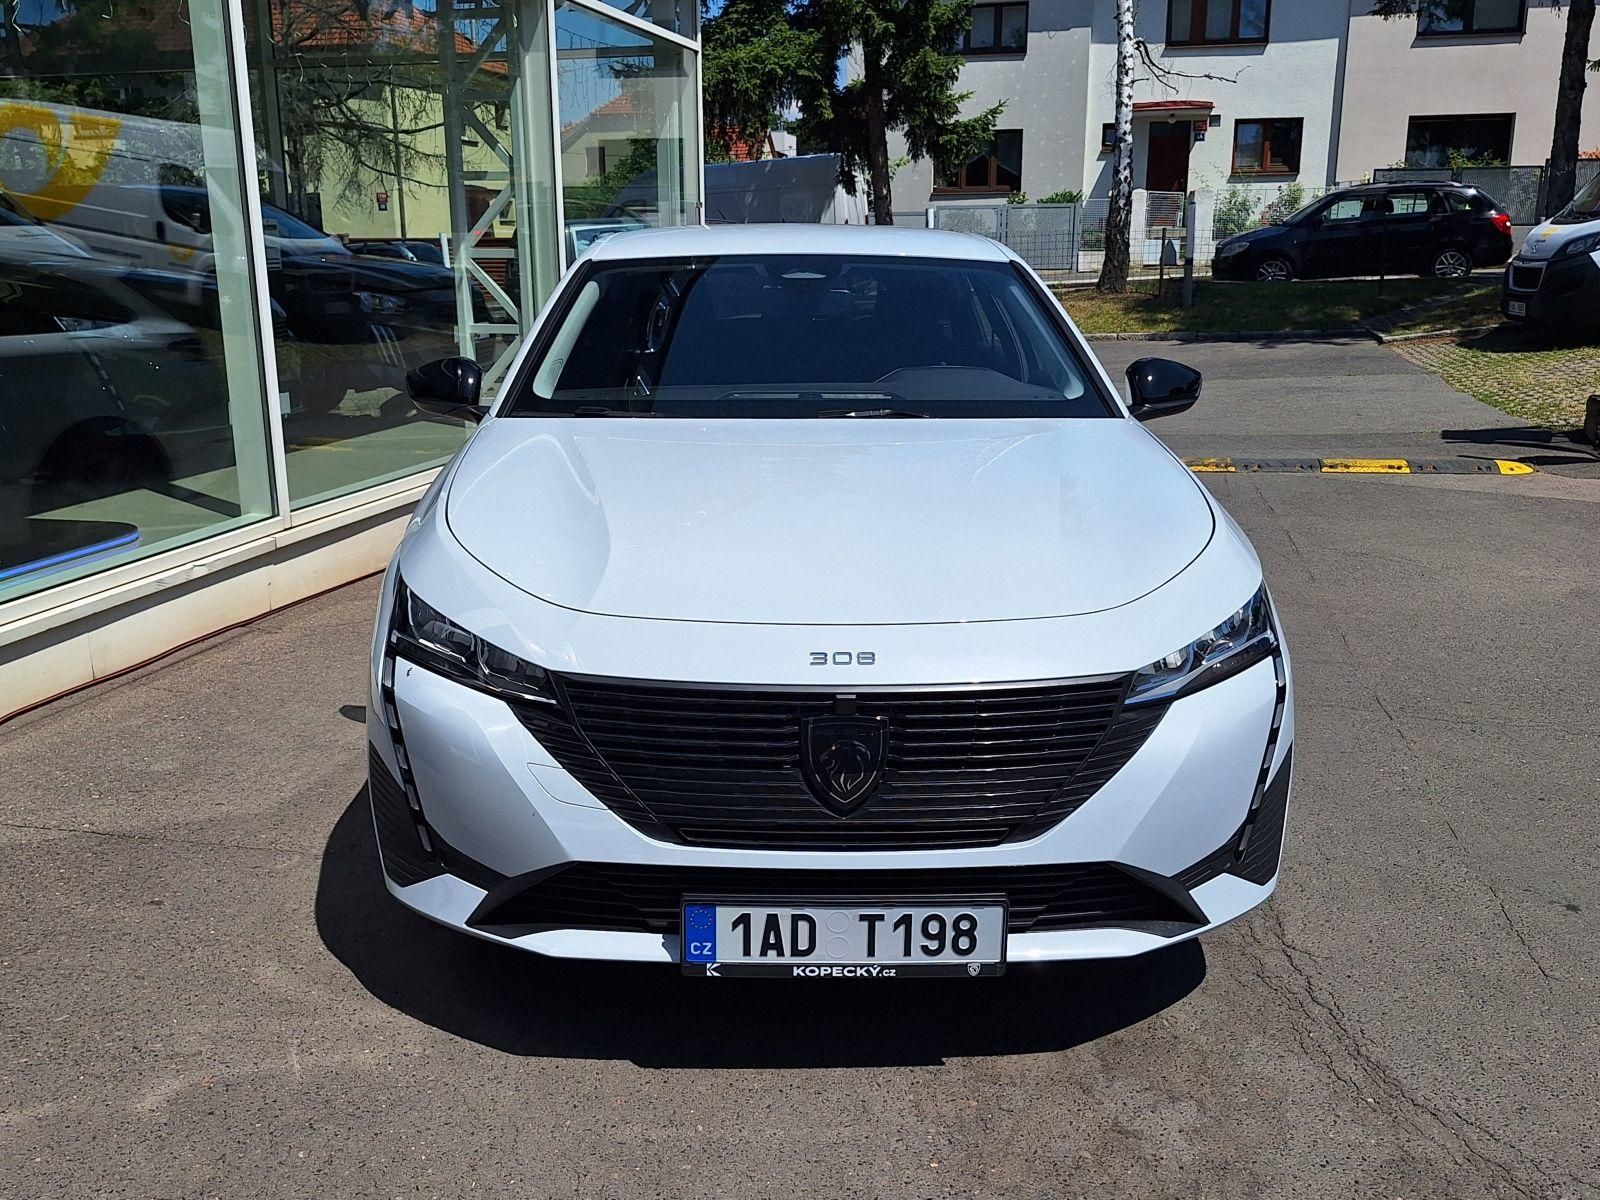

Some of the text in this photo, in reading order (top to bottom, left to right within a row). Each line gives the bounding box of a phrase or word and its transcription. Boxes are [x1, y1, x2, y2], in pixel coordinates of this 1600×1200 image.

[809, 651, 876, 666] 308
[731, 912, 978, 958] 1AD T198
[690, 942, 712, 955] CZ
